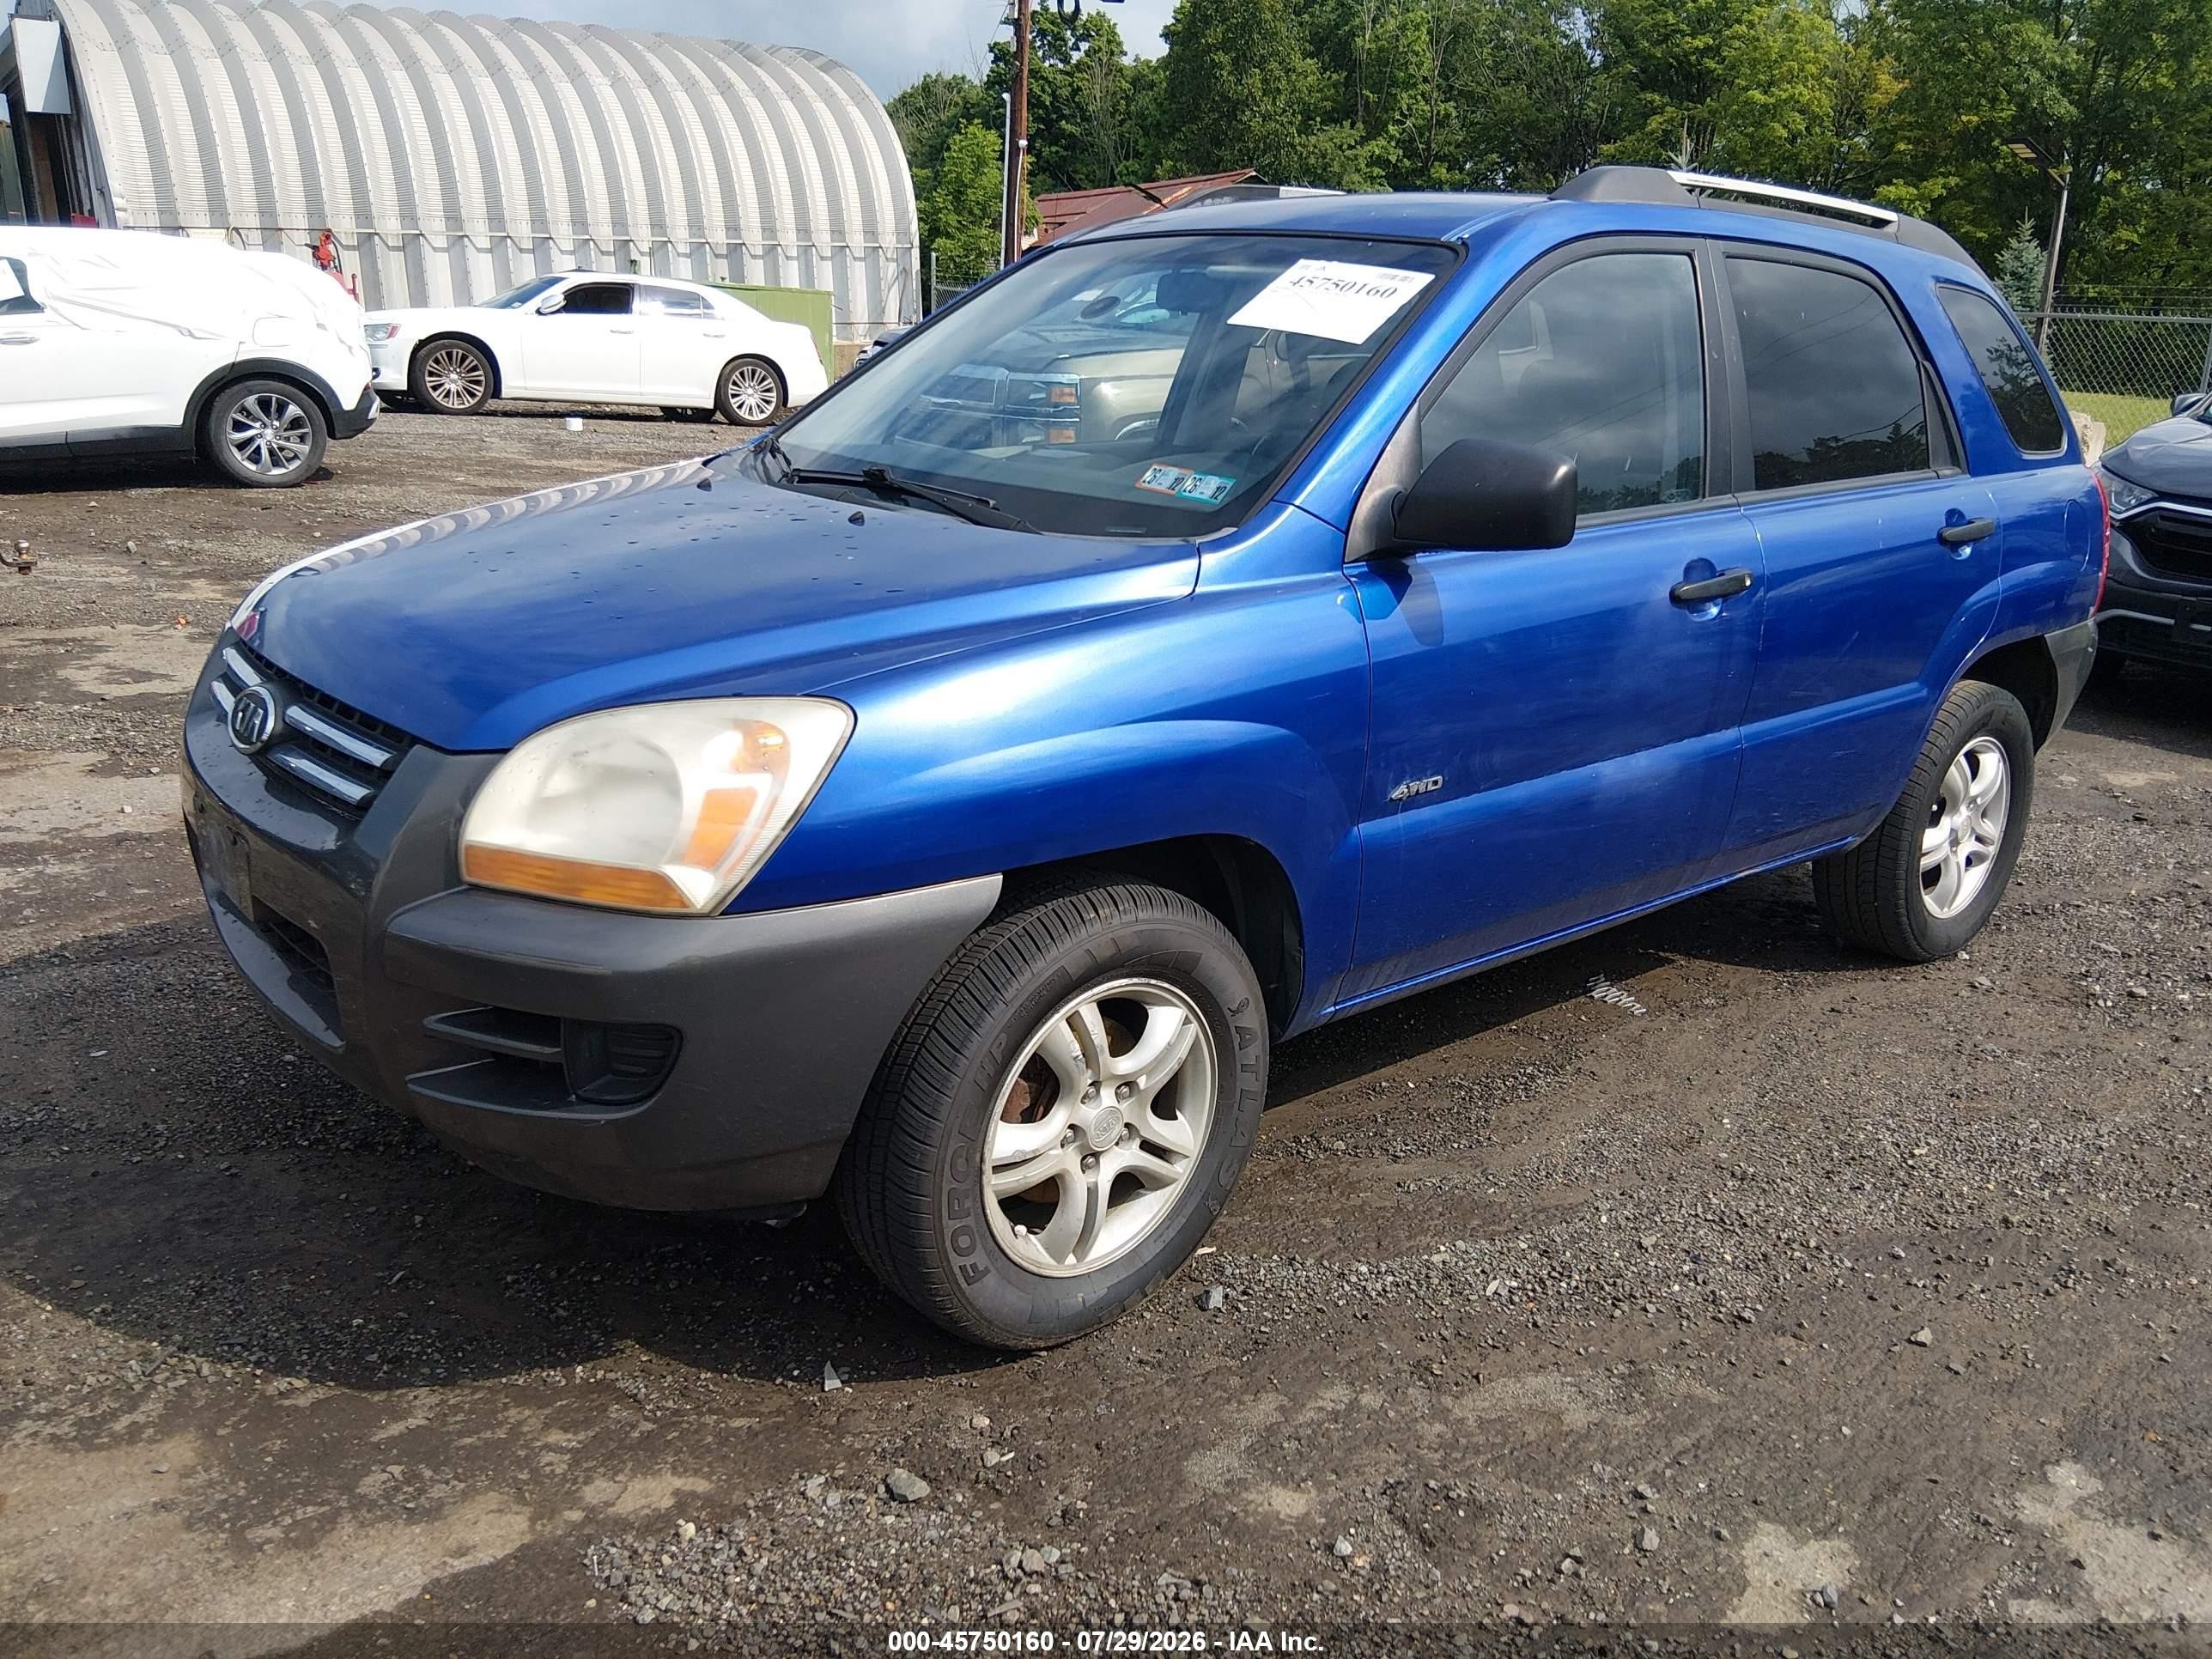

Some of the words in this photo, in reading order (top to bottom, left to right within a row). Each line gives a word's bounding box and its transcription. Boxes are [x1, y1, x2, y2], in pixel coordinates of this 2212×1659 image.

[1289, 275, 1398, 299] 45750160
[1387, 775, 1443, 800] 4WD
[1215, 1024, 1261, 1192] ATLAS
